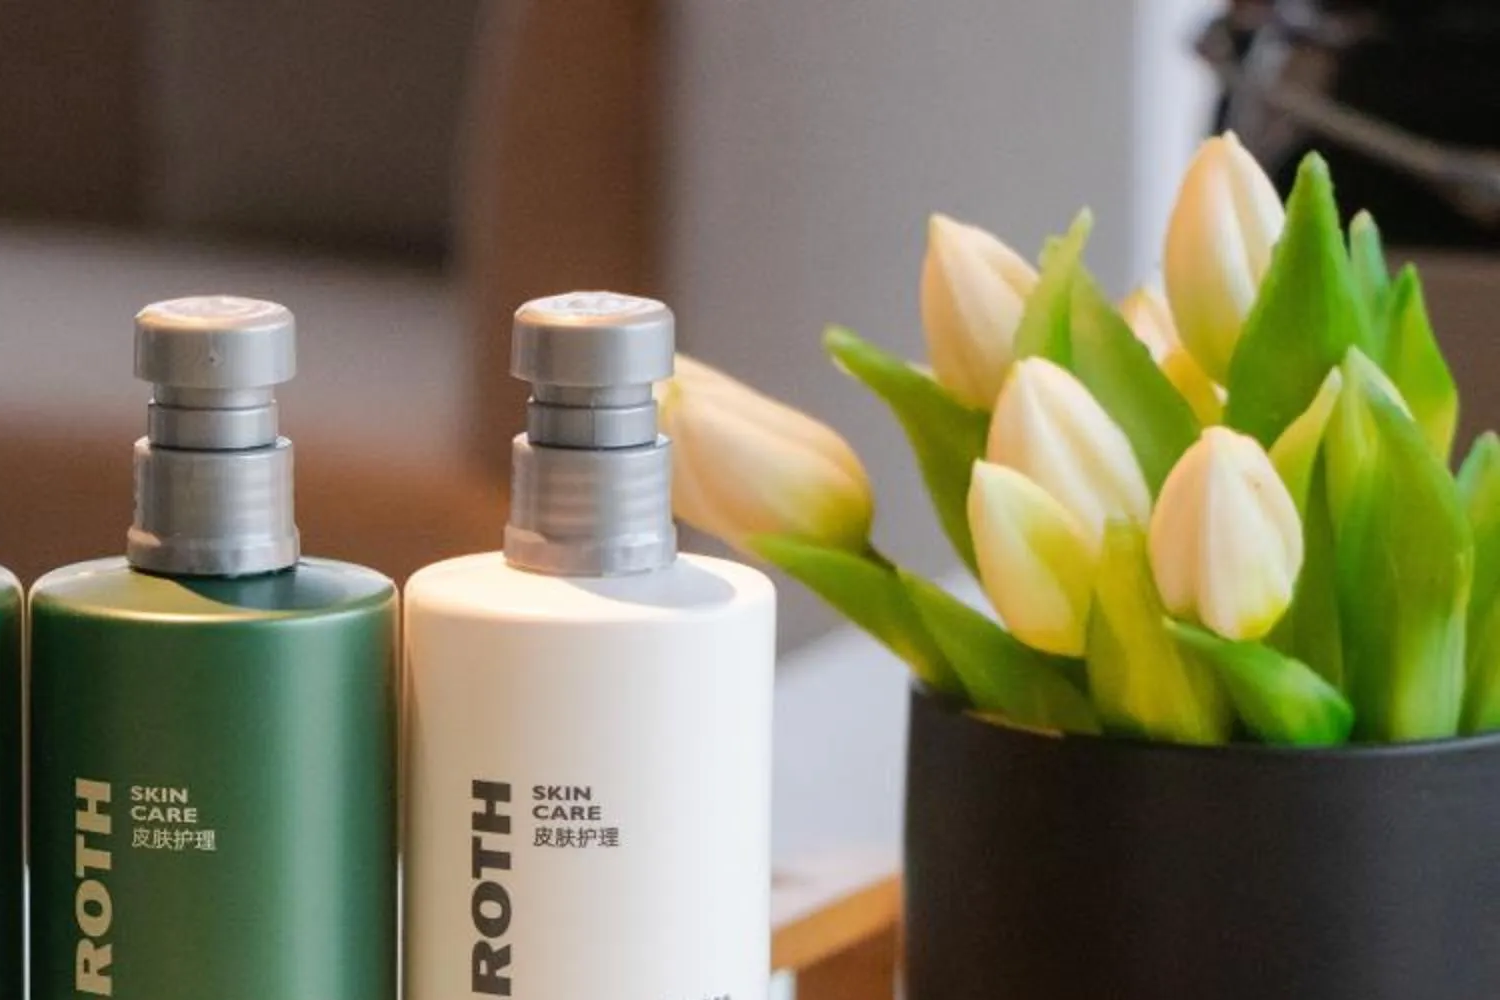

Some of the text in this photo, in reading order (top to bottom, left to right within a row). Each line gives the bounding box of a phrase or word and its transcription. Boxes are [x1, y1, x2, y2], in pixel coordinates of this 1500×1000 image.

[130, 785, 188, 804] SKIN
[532, 785, 592, 802] SKIN
[130, 805, 197, 824] CARE
[531, 804, 601, 821] CARE
[131, 827, 216, 851] 皮肤护理
[533, 826, 619, 849] 皮肤护理
